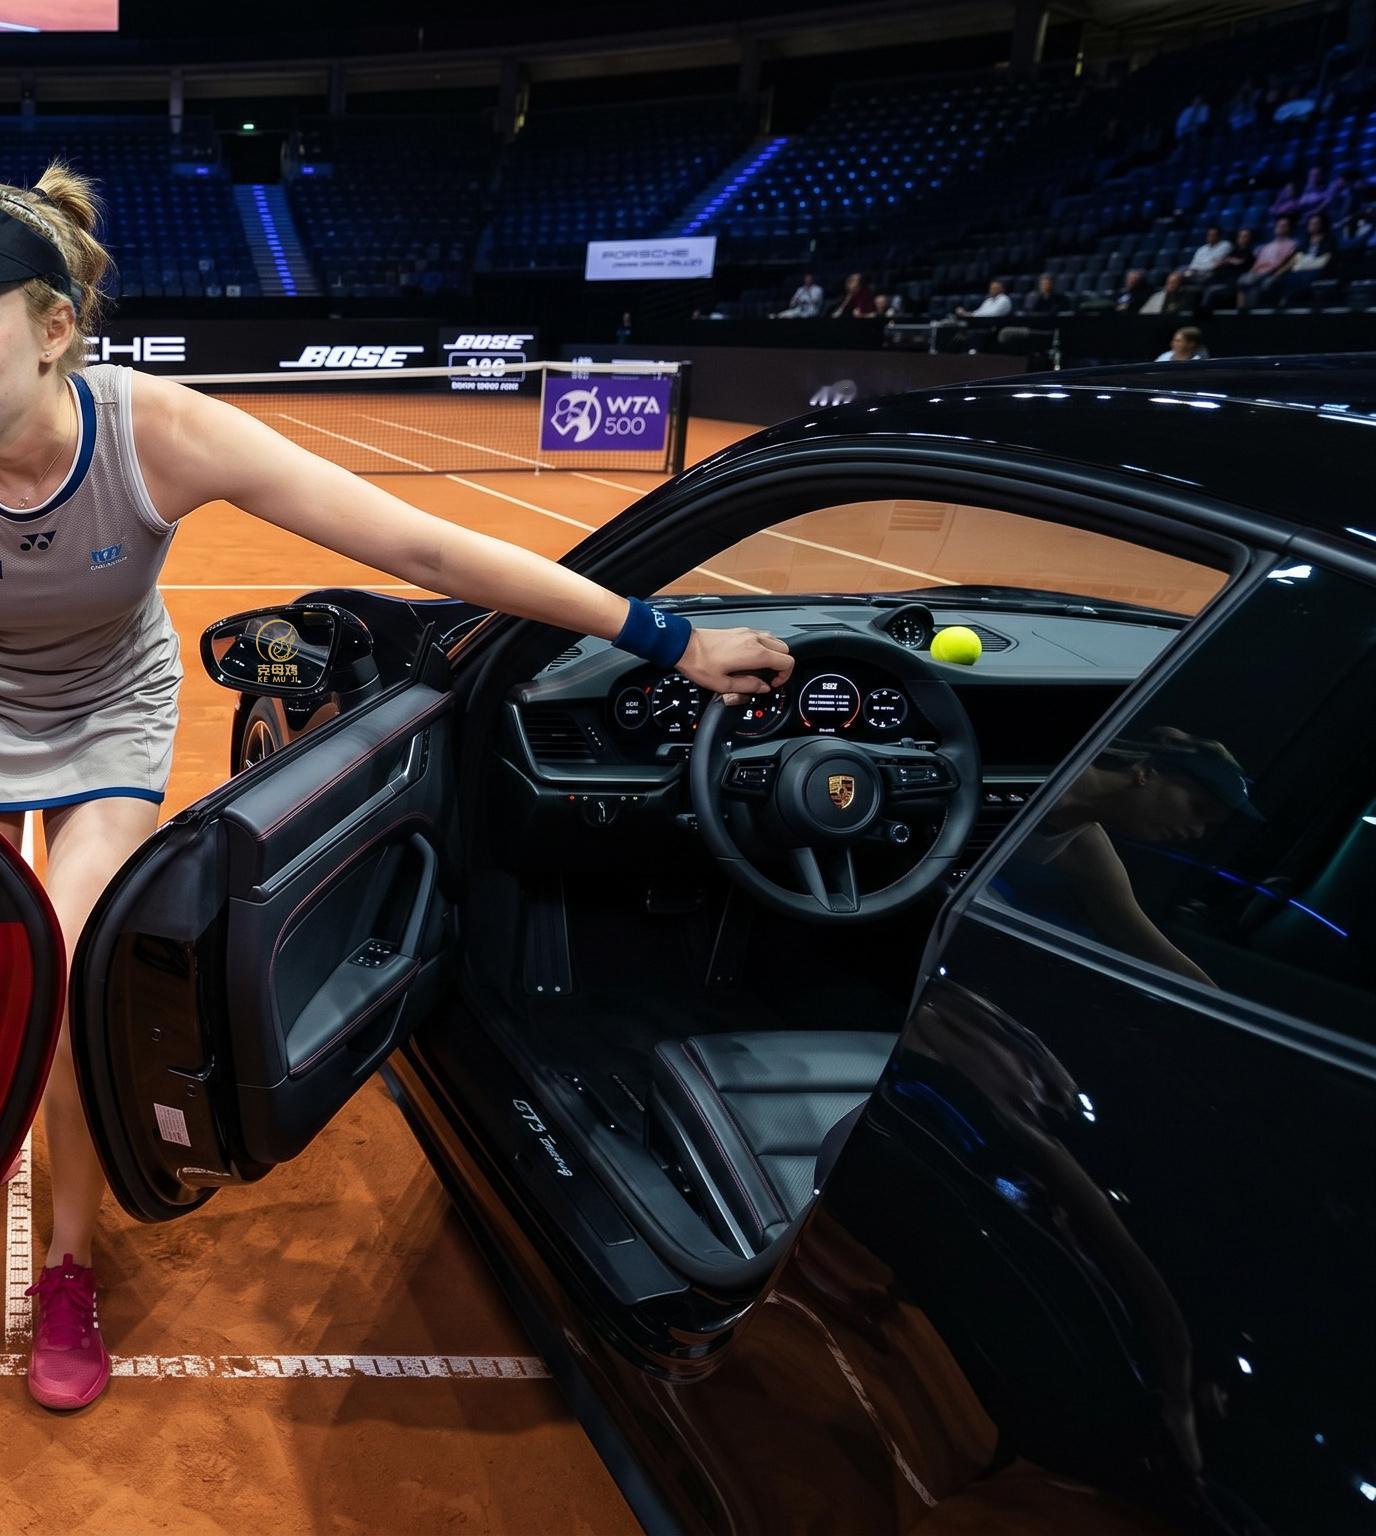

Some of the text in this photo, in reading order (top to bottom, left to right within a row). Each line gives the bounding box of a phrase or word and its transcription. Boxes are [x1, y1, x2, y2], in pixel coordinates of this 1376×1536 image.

[443, 334, 534, 350] BOSE
[279, 346, 424, 368] BOSE
[606, 396, 661, 415] WTA
[604, 417, 646, 436] 500
